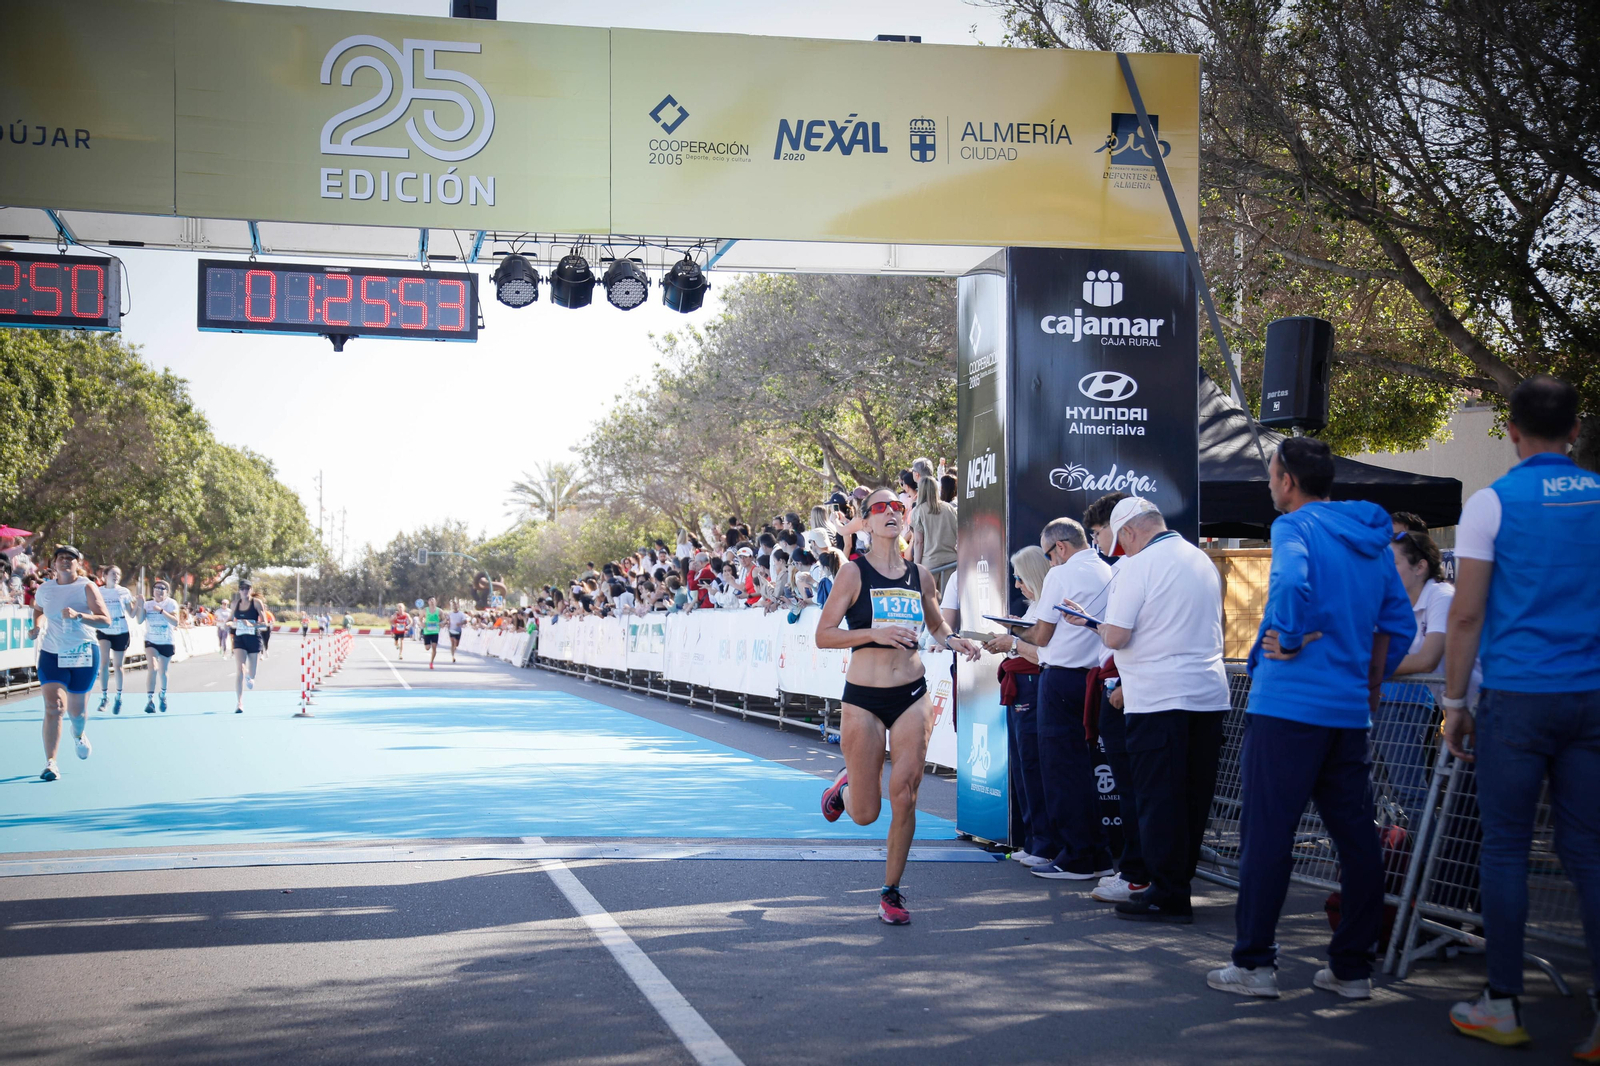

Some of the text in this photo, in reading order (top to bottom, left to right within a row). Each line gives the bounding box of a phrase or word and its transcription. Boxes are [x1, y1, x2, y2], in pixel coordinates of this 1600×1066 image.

[320, 34, 495, 162] 25
[0, 119, 91, 149] ÚJAR
[960, 118, 1073, 145] ALMERÍA
[648, 139, 749, 156] COOPERACIÓN
[960, 146, 1019, 161] CIUDAD
[648, 152, 683, 166] 2005
[782, 152, 806, 162] 2020
[1102, 171, 1148, 181] DEPORTES
[320, 166, 496, 207] EDICIÓN
[1040, 308, 1165, 343] cajamar
[1100, 336, 1162, 348] CAJA RURAL
[1065, 406, 1148, 421] HYUNDAI
[1068, 422, 1146, 436] Almerialva
[879, 596, 920, 615] 1378
